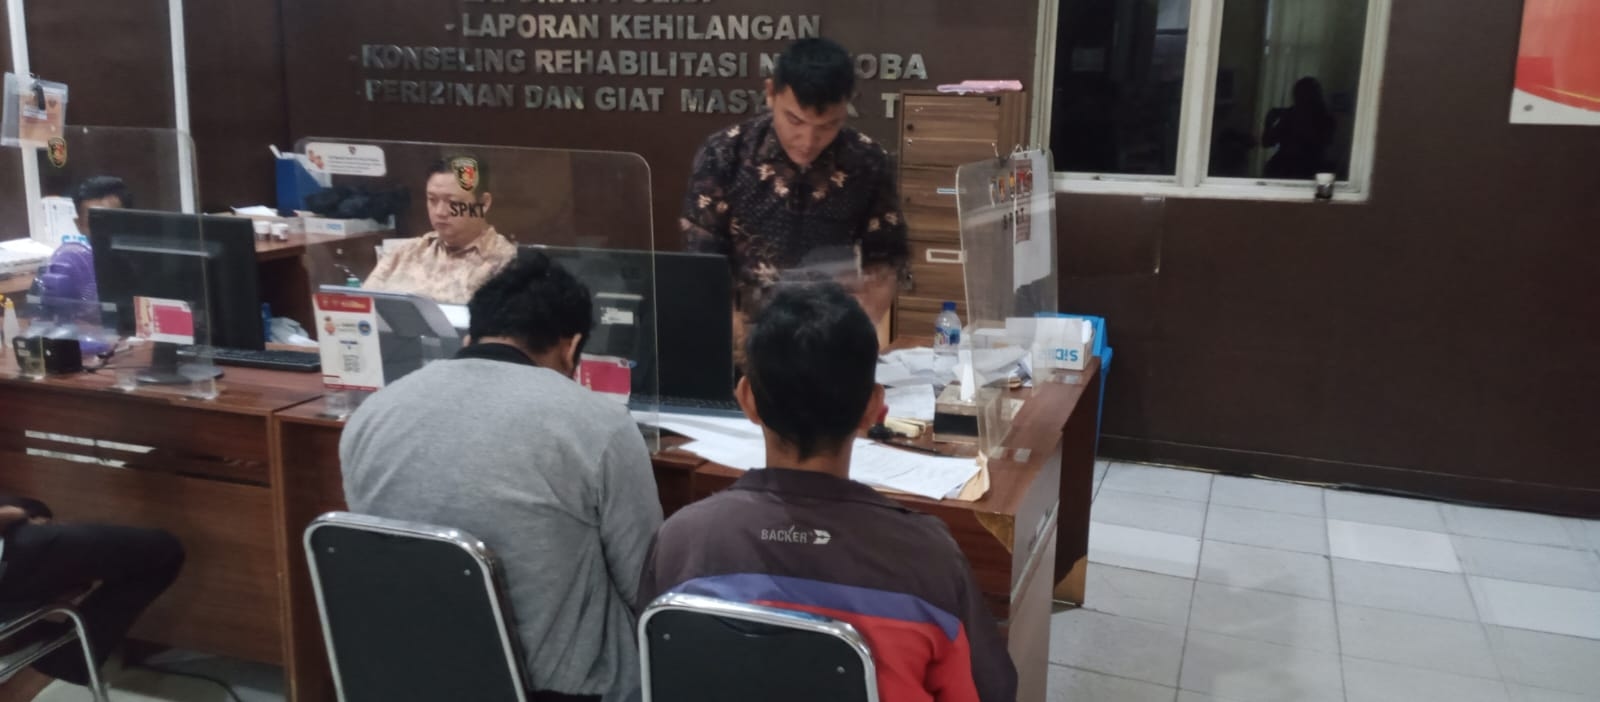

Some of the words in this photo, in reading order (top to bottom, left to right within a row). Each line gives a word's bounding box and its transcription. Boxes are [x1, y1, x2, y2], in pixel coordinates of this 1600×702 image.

[610, 15, 820, 40] KEHILANGAN
[535, 50, 748, 77] REHABILITASI
[525, 85, 584, 110] DAN
[595, 87, 664, 112] GIAT
[449, 201, 486, 218] SPKT
[761, 525, 807, 544] BACKER
